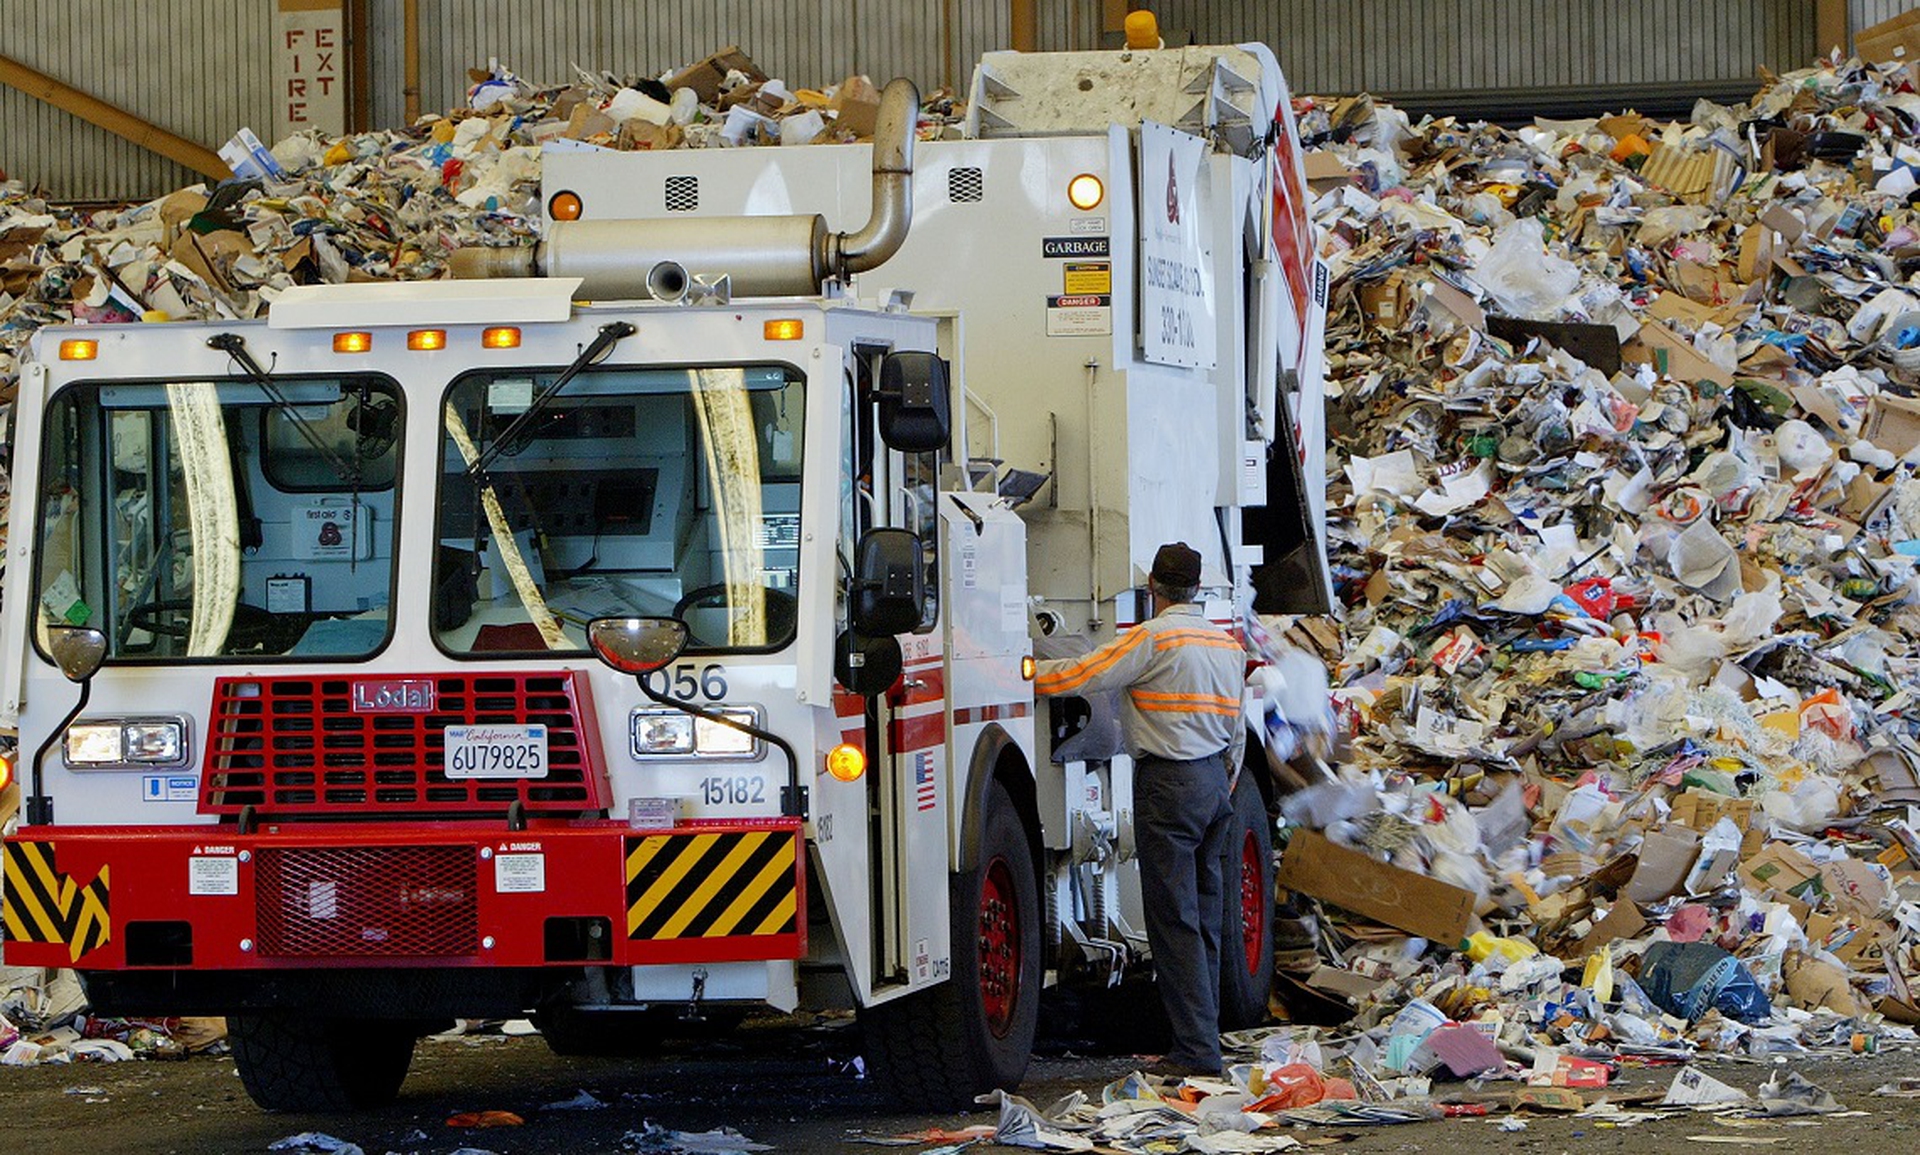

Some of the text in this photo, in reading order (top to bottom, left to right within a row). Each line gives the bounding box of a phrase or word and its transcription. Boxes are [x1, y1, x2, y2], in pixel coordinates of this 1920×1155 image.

[315, 28, 334, 96] EXT
[286, 30, 306, 122] FIRE
[1045, 241, 1108, 254] GARBAGE
[1061, 298, 1096, 306] DANGER
[306, 510, 337, 519] first aid
[465, 728, 524, 744] California
[452, 744, 541, 770] 6U79825
[700, 777, 766, 805] 15182
[205, 846, 235, 854] DANGER
[510, 842, 541, 851] DANGER
